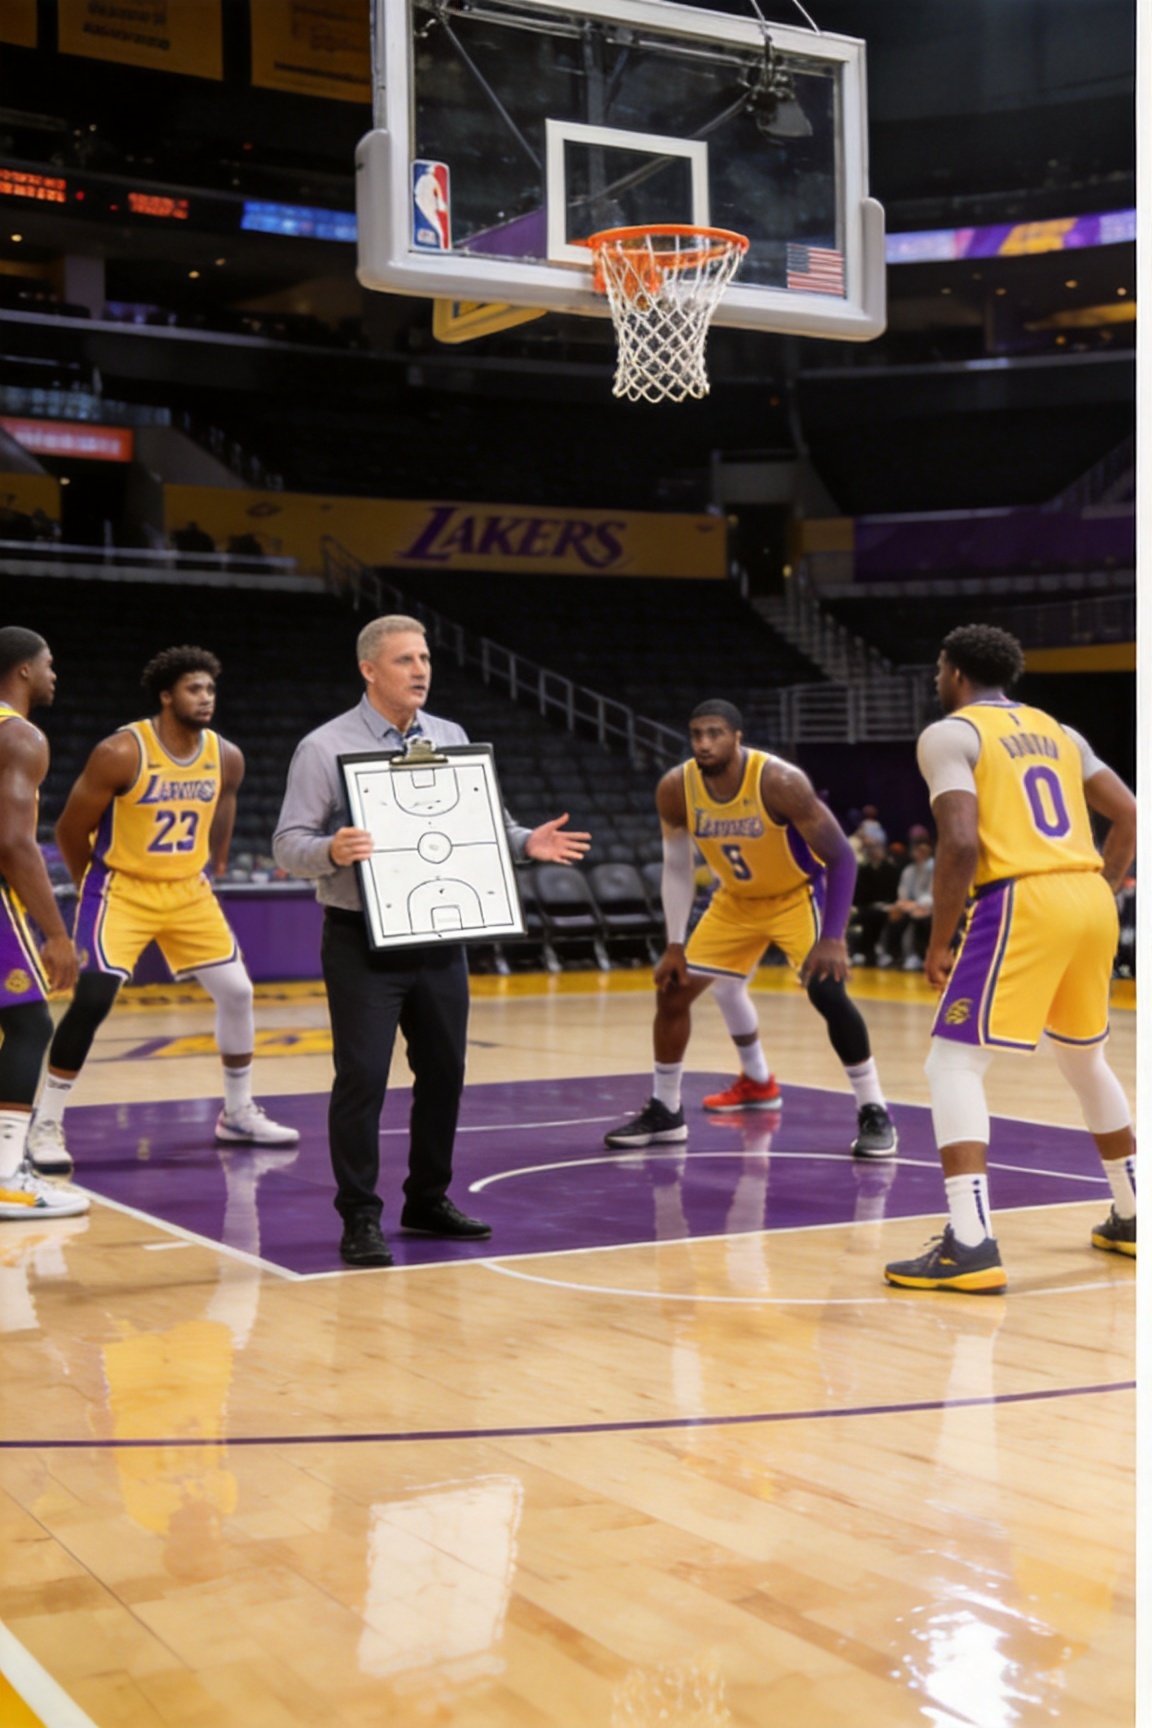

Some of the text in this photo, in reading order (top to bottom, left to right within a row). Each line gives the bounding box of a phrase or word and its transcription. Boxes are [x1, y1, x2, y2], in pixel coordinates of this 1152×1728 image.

[402, 505, 629, 569] LAKERS
[147, 810, 199, 853] 23
[1023, 765, 1071, 838] 0
